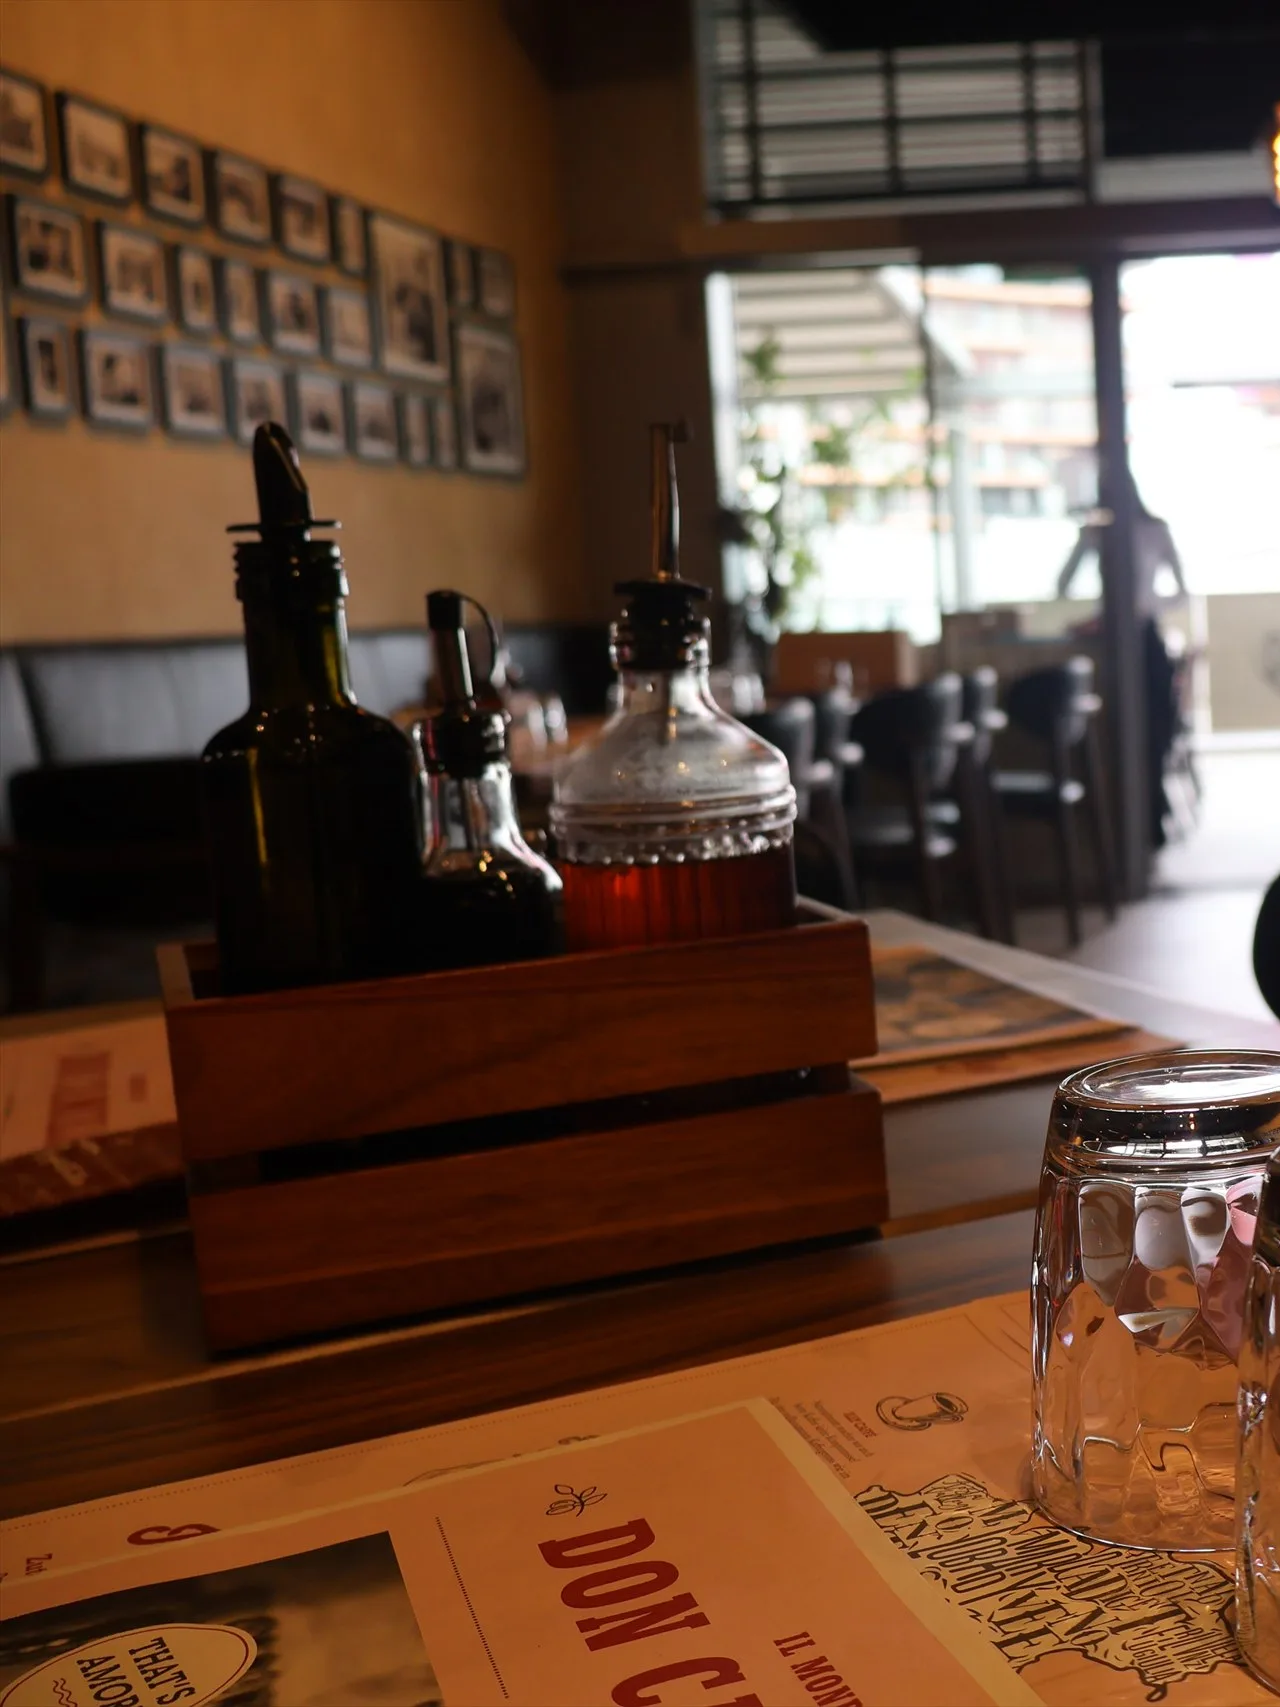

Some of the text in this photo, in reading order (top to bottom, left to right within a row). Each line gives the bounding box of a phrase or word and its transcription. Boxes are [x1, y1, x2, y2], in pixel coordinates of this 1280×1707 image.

[537, 1517, 711, 1652] DON
[128, 1636, 196, 1706] THAT'S
[773, 1631, 816, 1658] IL
[76, 1655, 142, 1707] AMOR
